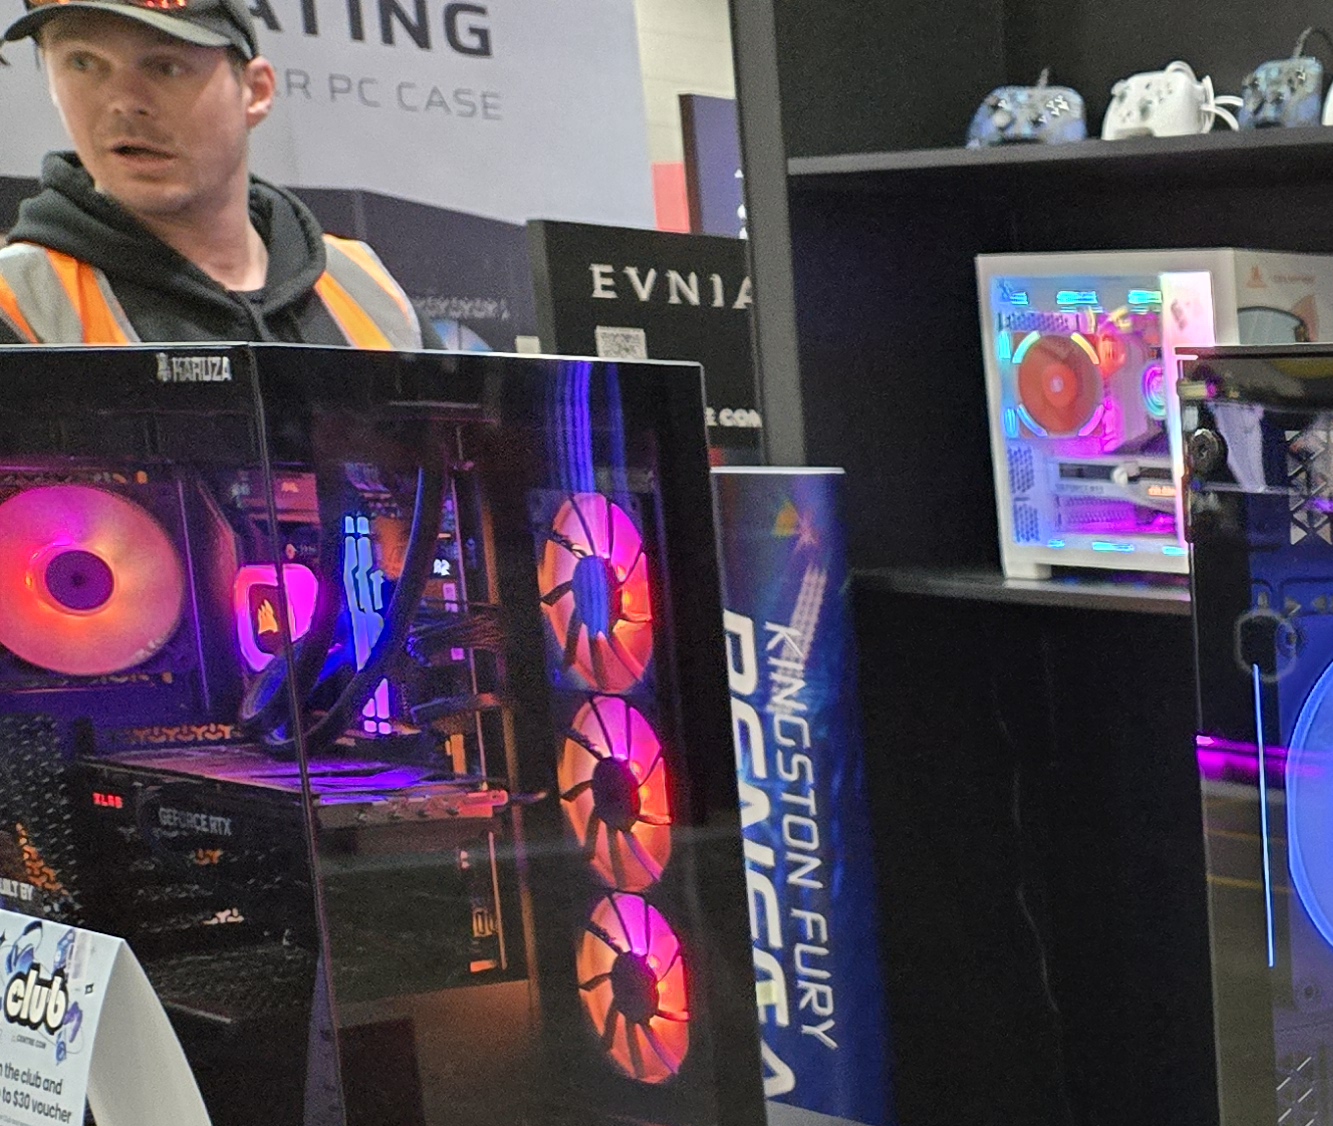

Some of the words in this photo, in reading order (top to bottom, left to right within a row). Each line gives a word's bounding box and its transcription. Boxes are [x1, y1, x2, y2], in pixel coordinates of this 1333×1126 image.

[329, 73, 380, 107] PC
[396, 82, 502, 121] CASE
[172, 356, 232, 381] KARUZA
[764, 621, 823, 891] KINGSTON
[6, 967, 67, 1029] club
[791, 907, 838, 1050] FURY
[4, 1061, 19, 1082] the
[20, 1068, 41, 1089] club
[43, 1078, 63, 1096] and
[2, 1086, 11, 1105] to
[13, 1090, 30, 1111] $30
[32, 1098, 72, 1124] voucher
